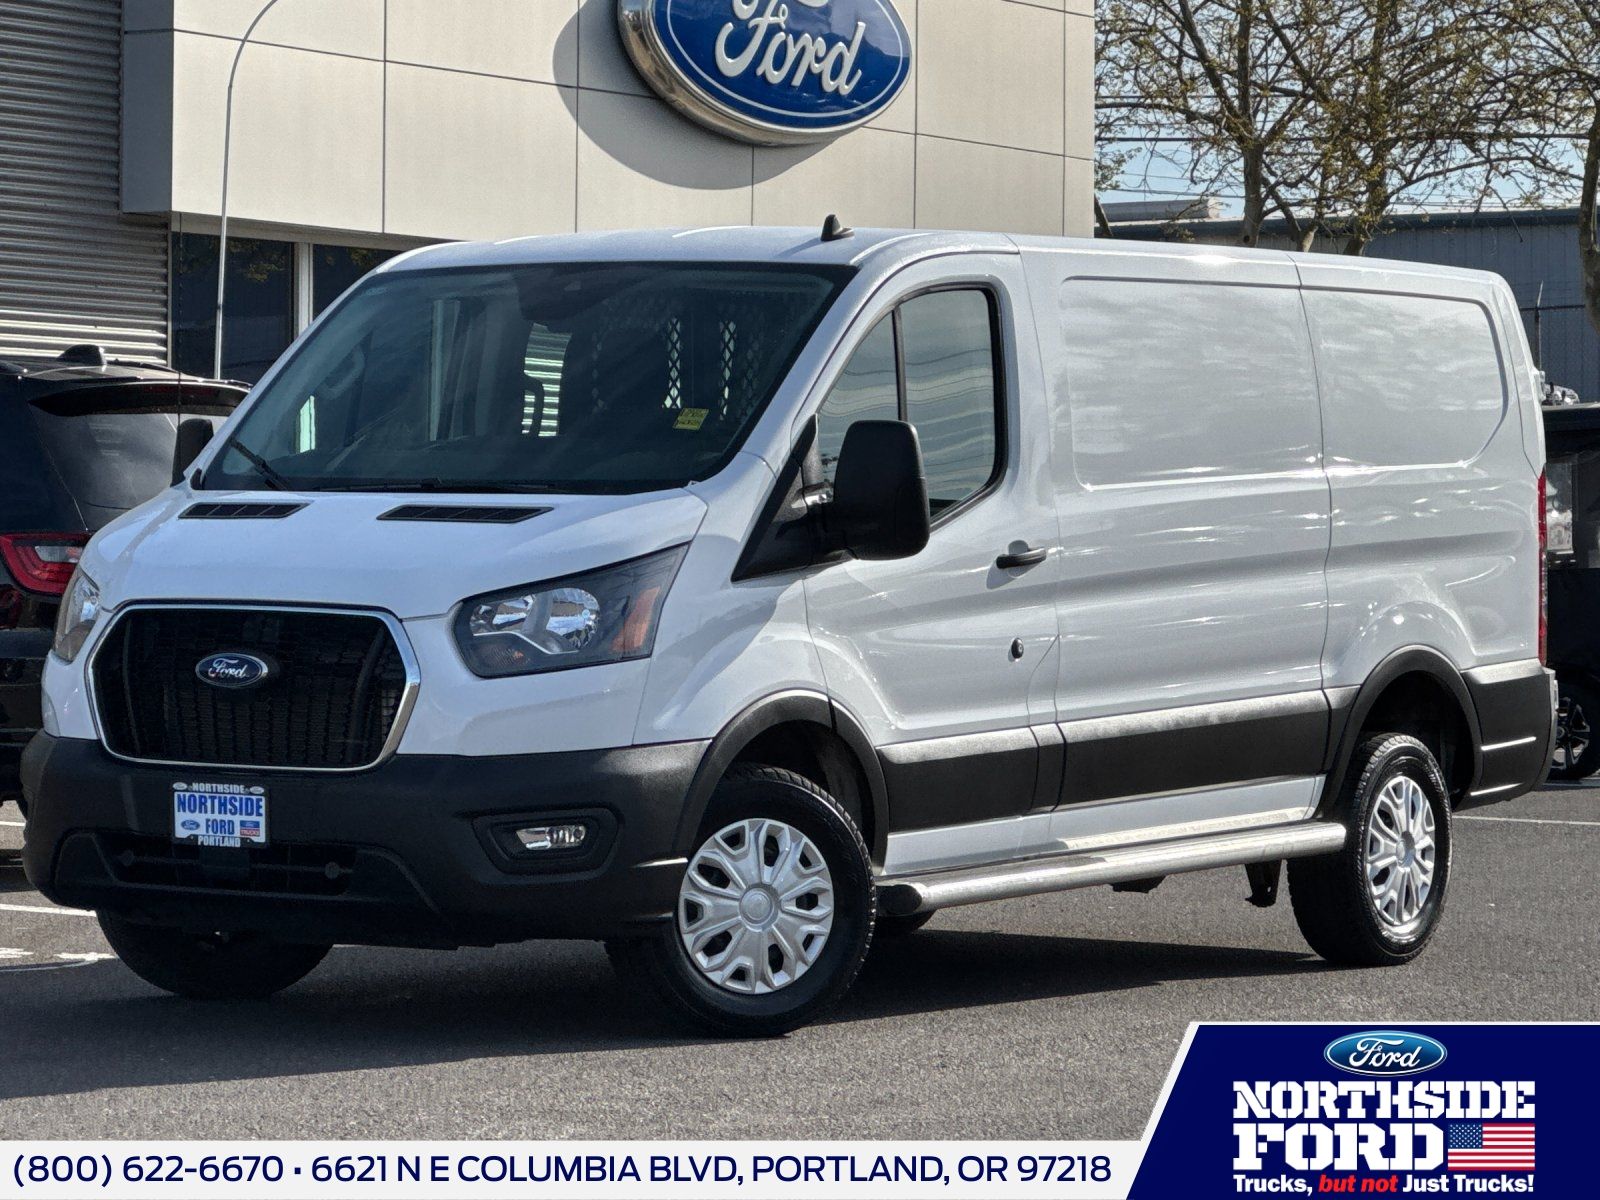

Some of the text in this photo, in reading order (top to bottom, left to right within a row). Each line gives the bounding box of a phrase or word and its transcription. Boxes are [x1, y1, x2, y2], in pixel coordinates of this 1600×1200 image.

[715, 0, 865, 95] Ford
[208, 658, 248, 678] Ford
[192, 782, 246, 794] NORTHSIDE
[177, 794, 263, 816] NORTHSIDE
[205, 819, 235, 835] FORD
[198, 836, 241, 847] PORTLAND
